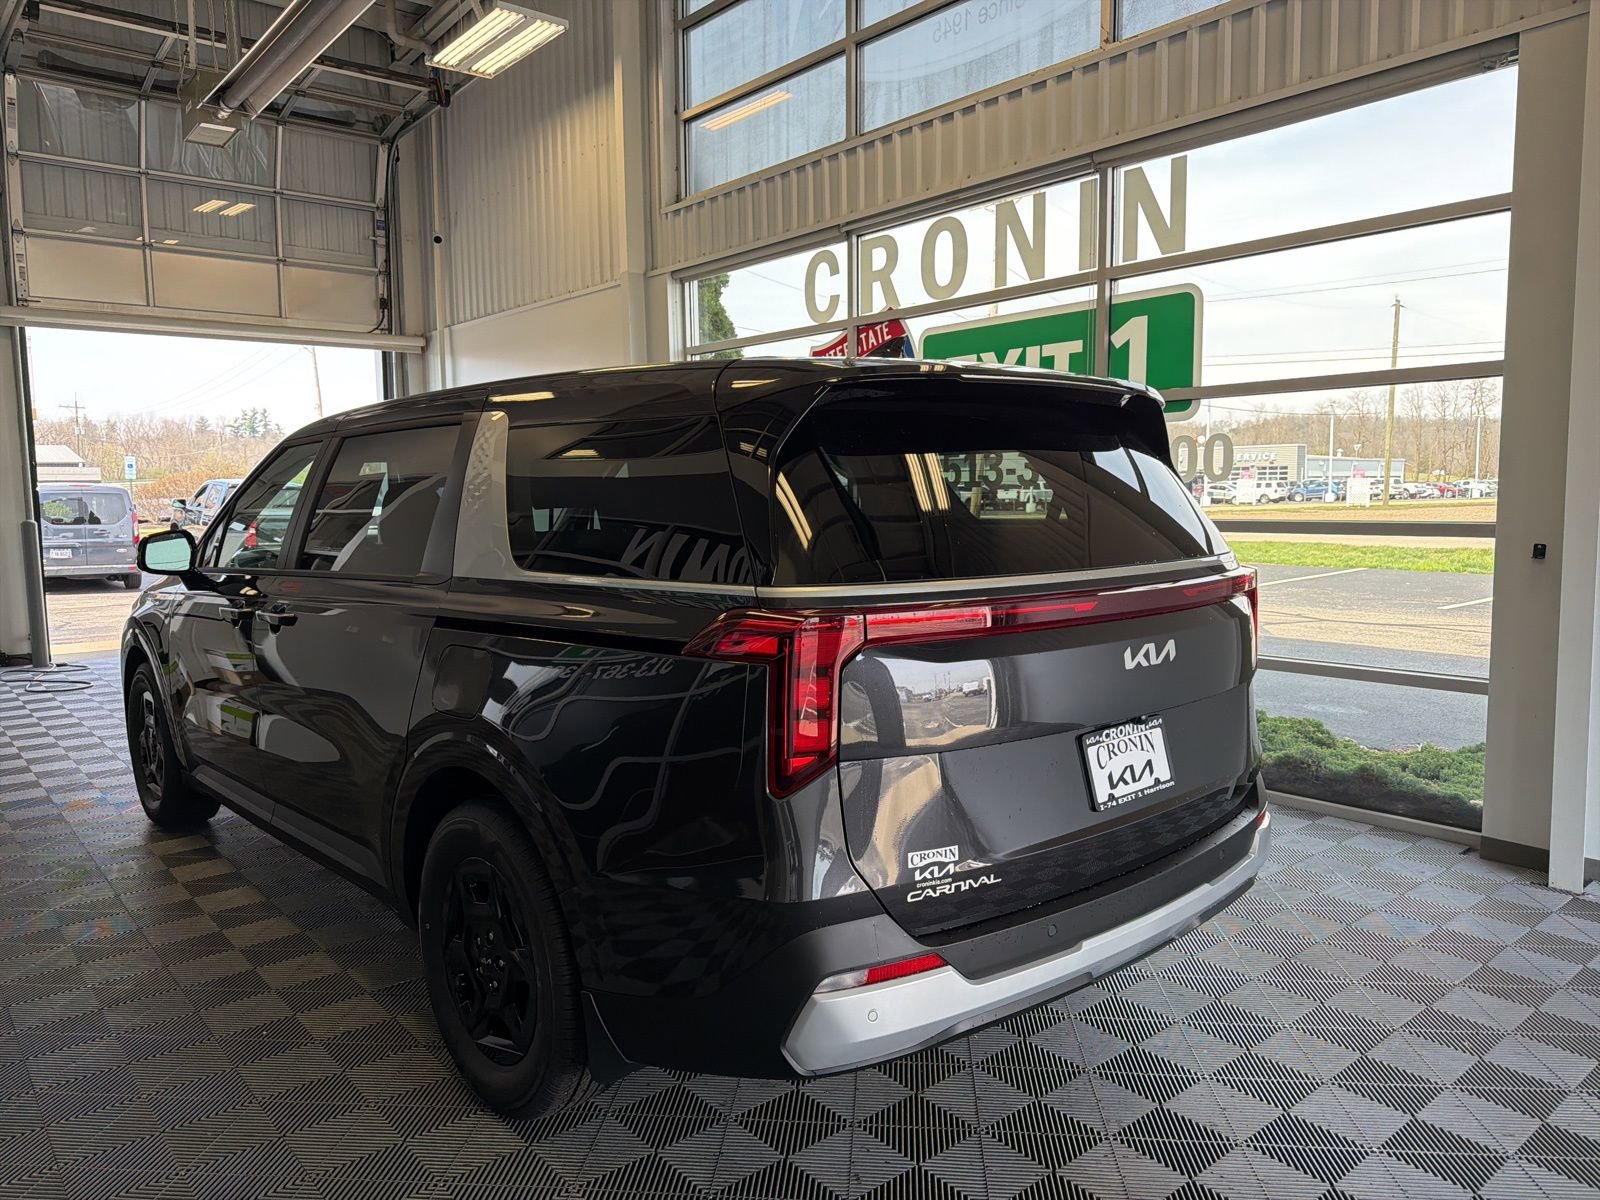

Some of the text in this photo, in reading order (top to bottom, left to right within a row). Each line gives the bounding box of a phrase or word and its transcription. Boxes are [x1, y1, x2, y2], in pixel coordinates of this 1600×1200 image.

[804, 155, 1187, 324] CRONIN
[1110, 315, 1148, 386] 1
[1123, 638, 1177, 670] KIA
[1096, 731, 1156, 770] CRONIN
[1107, 758, 1154, 791] KIA
[1100, 801, 1117, 811] I-74
[1118, 794, 1137, 804] EXIT
[1143, 781, 1176, 795] Harrison
[910, 847, 957, 867] CRONIN
[914, 863, 955, 881] KIA
[906, 873, 1002, 903] CARNIVAL
[916, 877, 953, 888] croninkia.com
